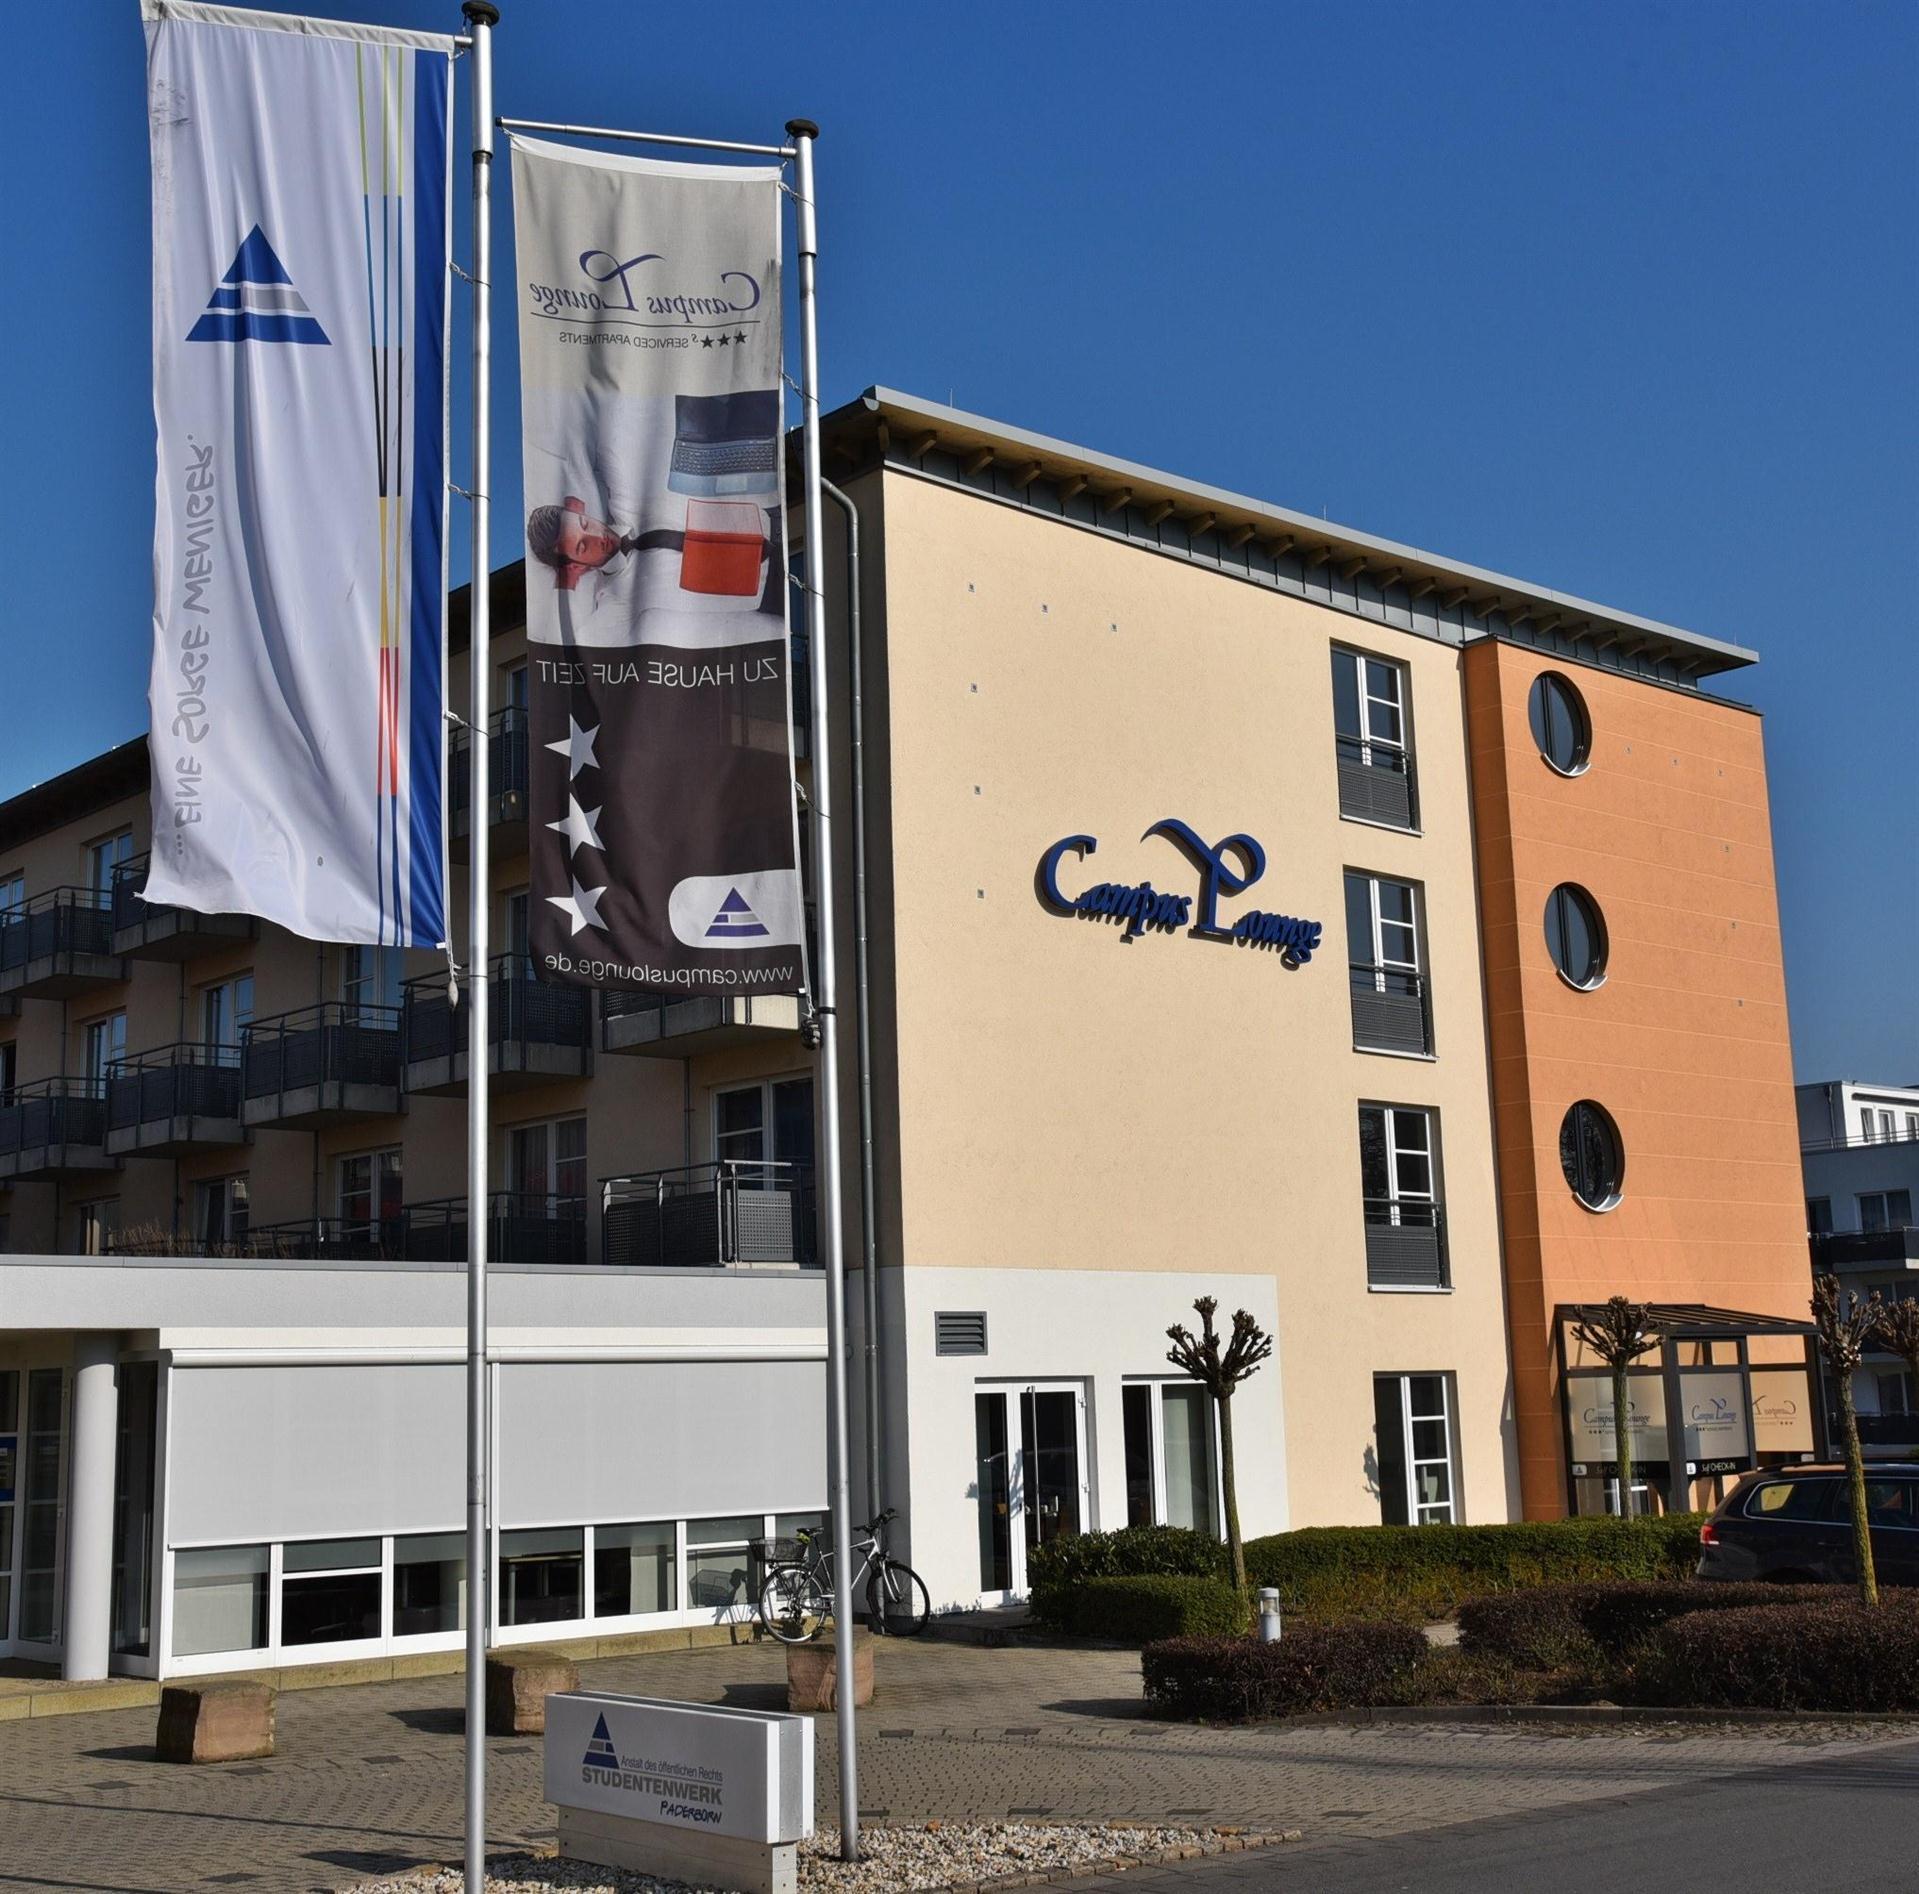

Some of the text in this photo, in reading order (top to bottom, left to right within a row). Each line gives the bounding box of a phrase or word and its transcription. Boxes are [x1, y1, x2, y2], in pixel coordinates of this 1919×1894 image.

[1035, 818, 1322, 968] Campus Lounge
[1583, 1407, 1617, 1426] Campu
[620, 1755, 723, 1782] Anstalt des öffentlichen Rechts
[582, 1766, 723, 1805] STUDENTENWERK
[660, 1800, 722, 1824] PADERBORN
